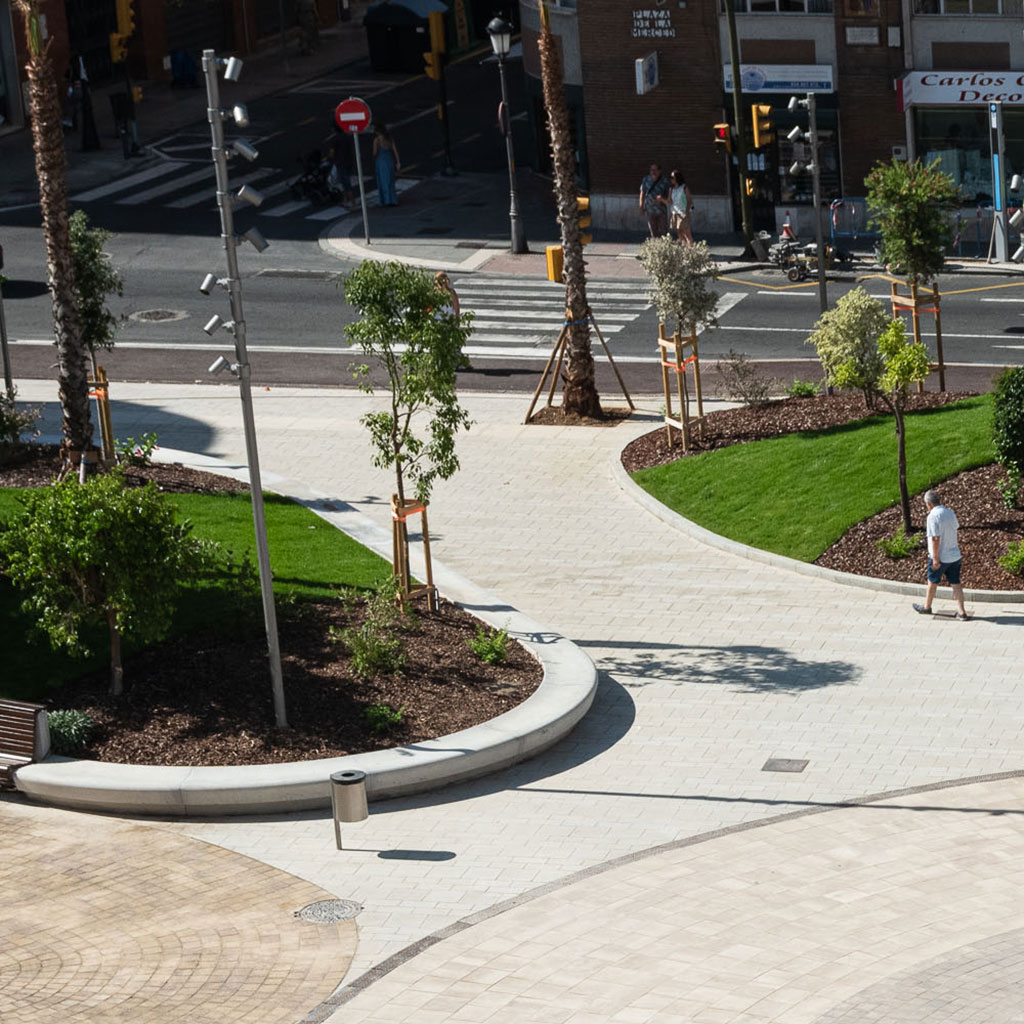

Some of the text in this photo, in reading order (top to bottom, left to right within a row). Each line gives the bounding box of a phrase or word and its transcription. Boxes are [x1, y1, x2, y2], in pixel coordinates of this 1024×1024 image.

[632, 9, 671, 19] PLAZA
[633, 19, 671, 28] DE LA
[632, 28, 676, 38] MERCED
[919, 72, 1006, 87] Carlos
